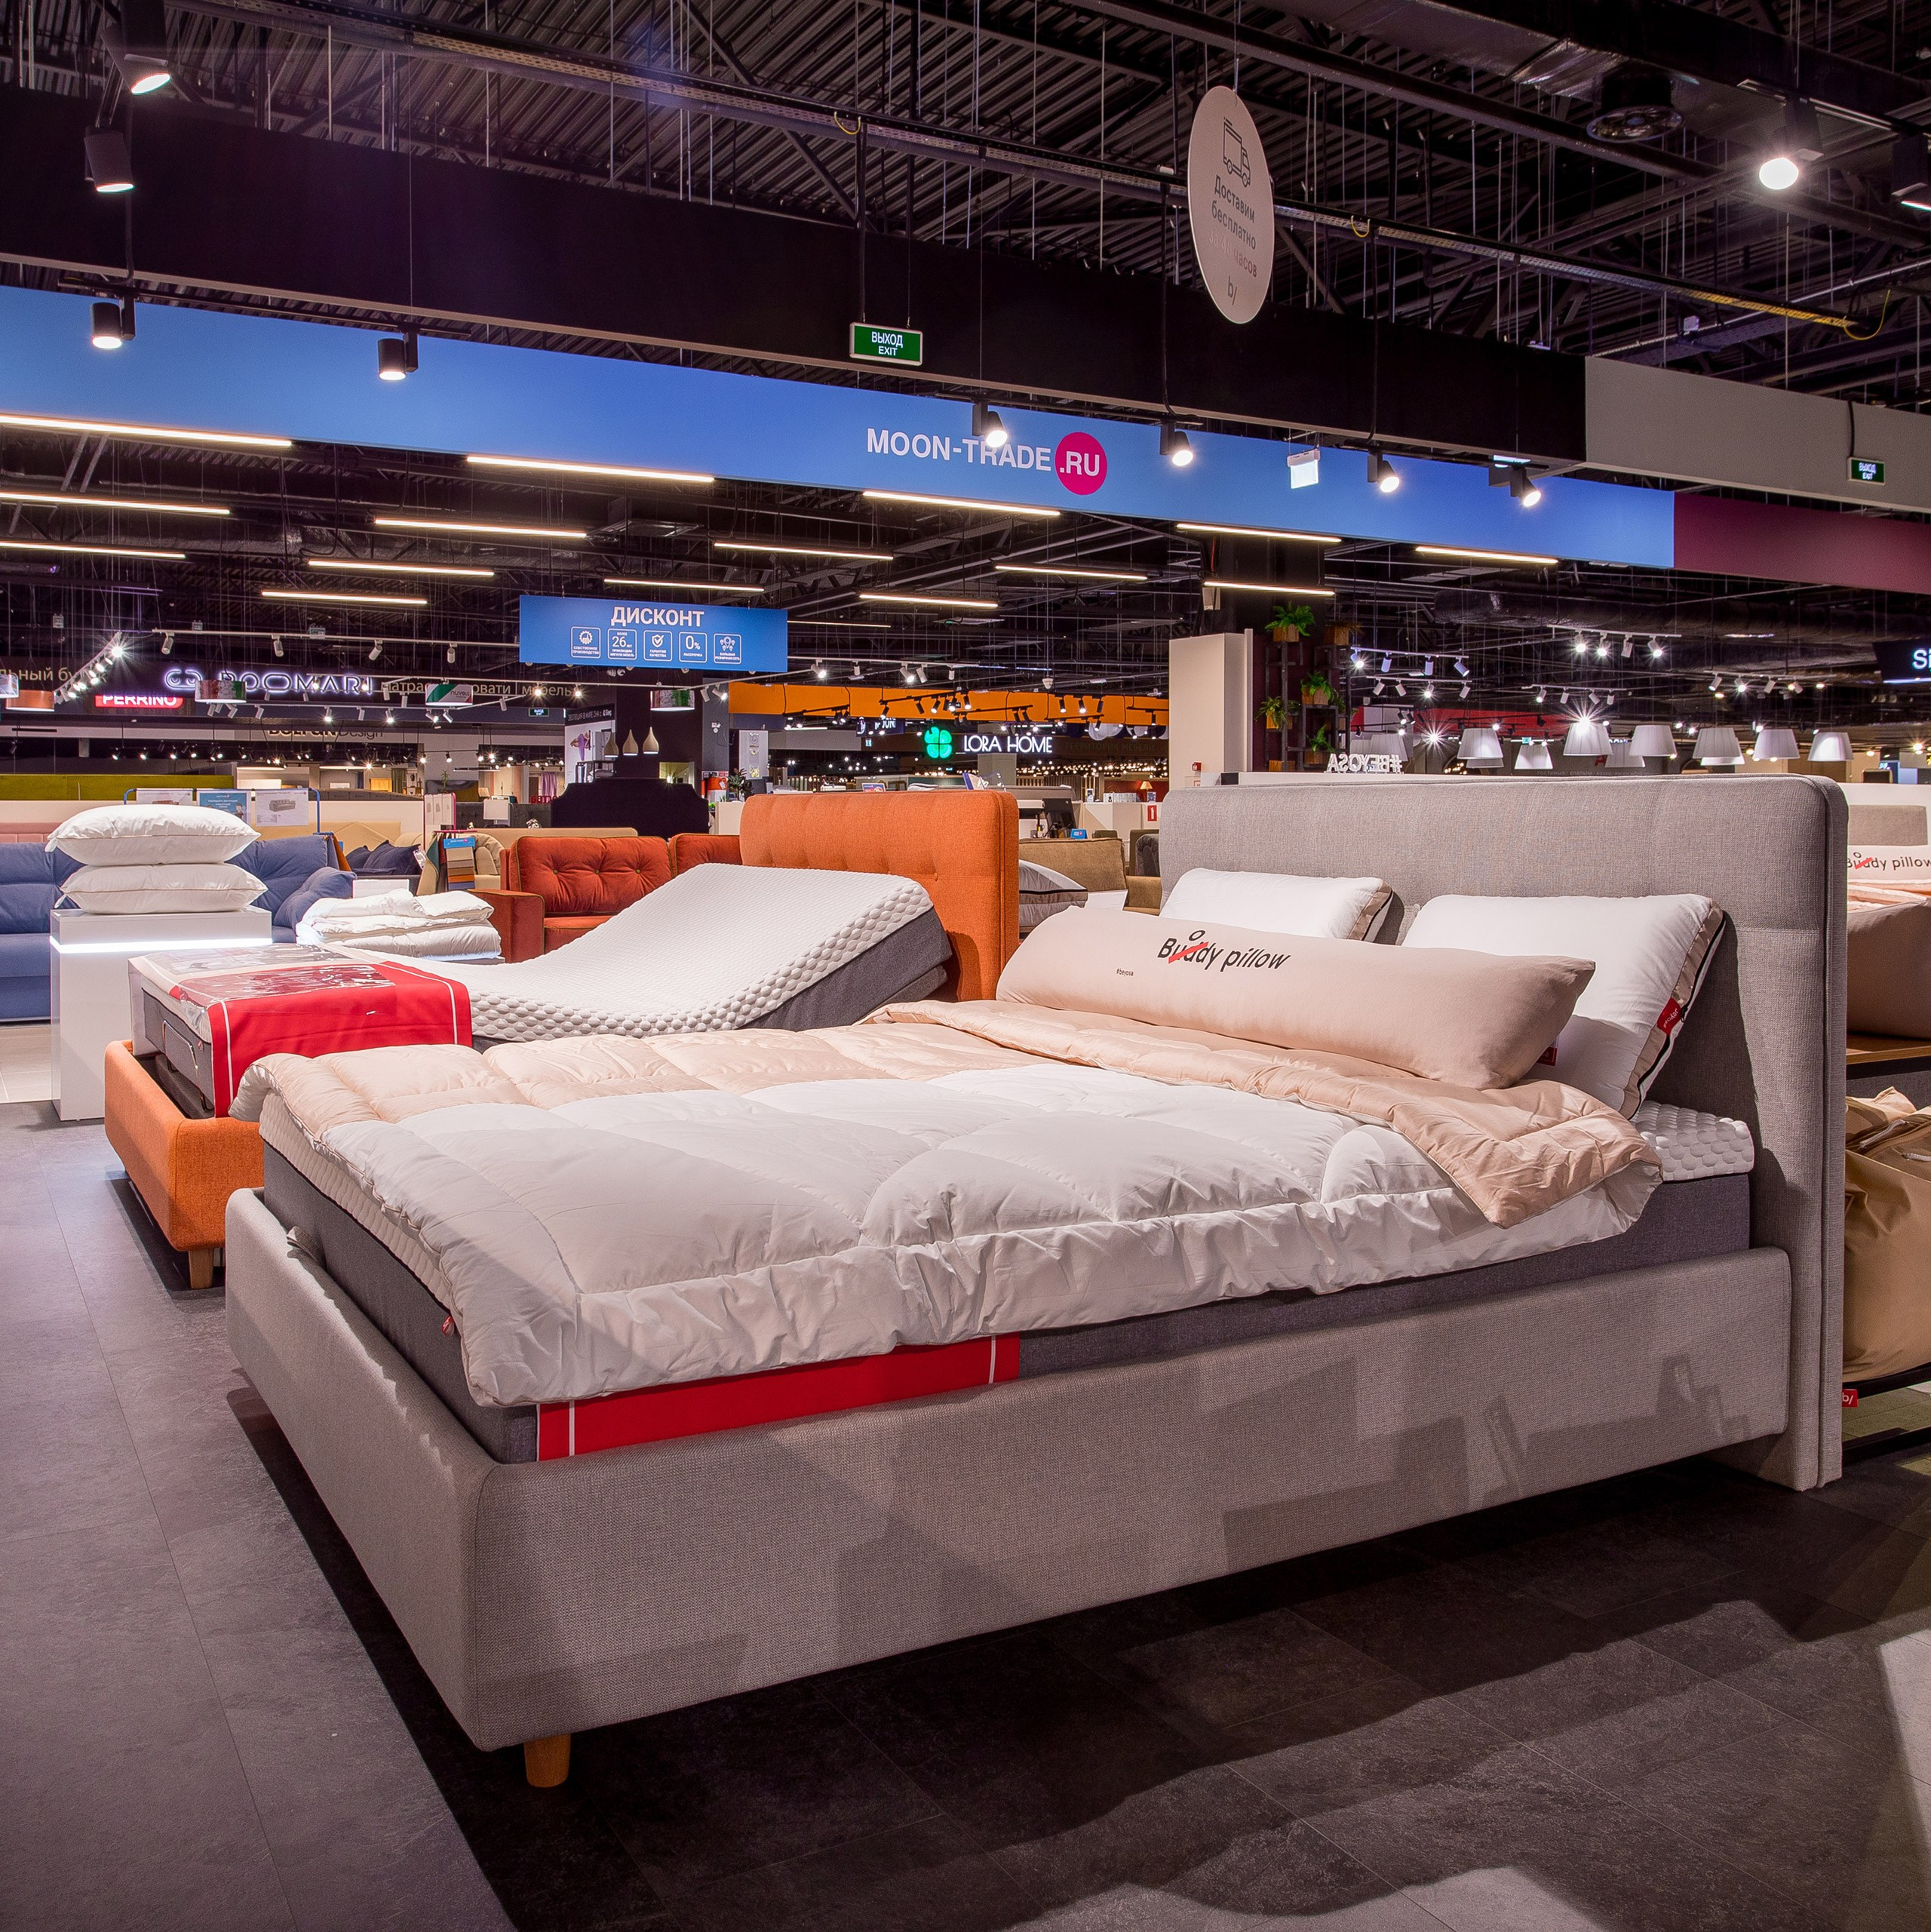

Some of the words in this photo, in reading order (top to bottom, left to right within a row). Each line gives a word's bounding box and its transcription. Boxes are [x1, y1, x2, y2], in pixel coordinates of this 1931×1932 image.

[1214, 174, 1255, 223] Доставим
[1211, 200, 1256, 250] бесплатно
[1233, 248, 1257, 278] часов
[871, 331, 904, 348] ВЫХОД
[878, 346, 898, 356] EXIT
[610, 606, 705, 627] ДИСКОНТ
[612, 636, 627, 647] 26
[686, 635, 701, 650] 0%
[964, 735, 1002, 752] LORA
[1007, 736, 1052, 753] HOME
[1220, 948, 1291, 972] pillow
